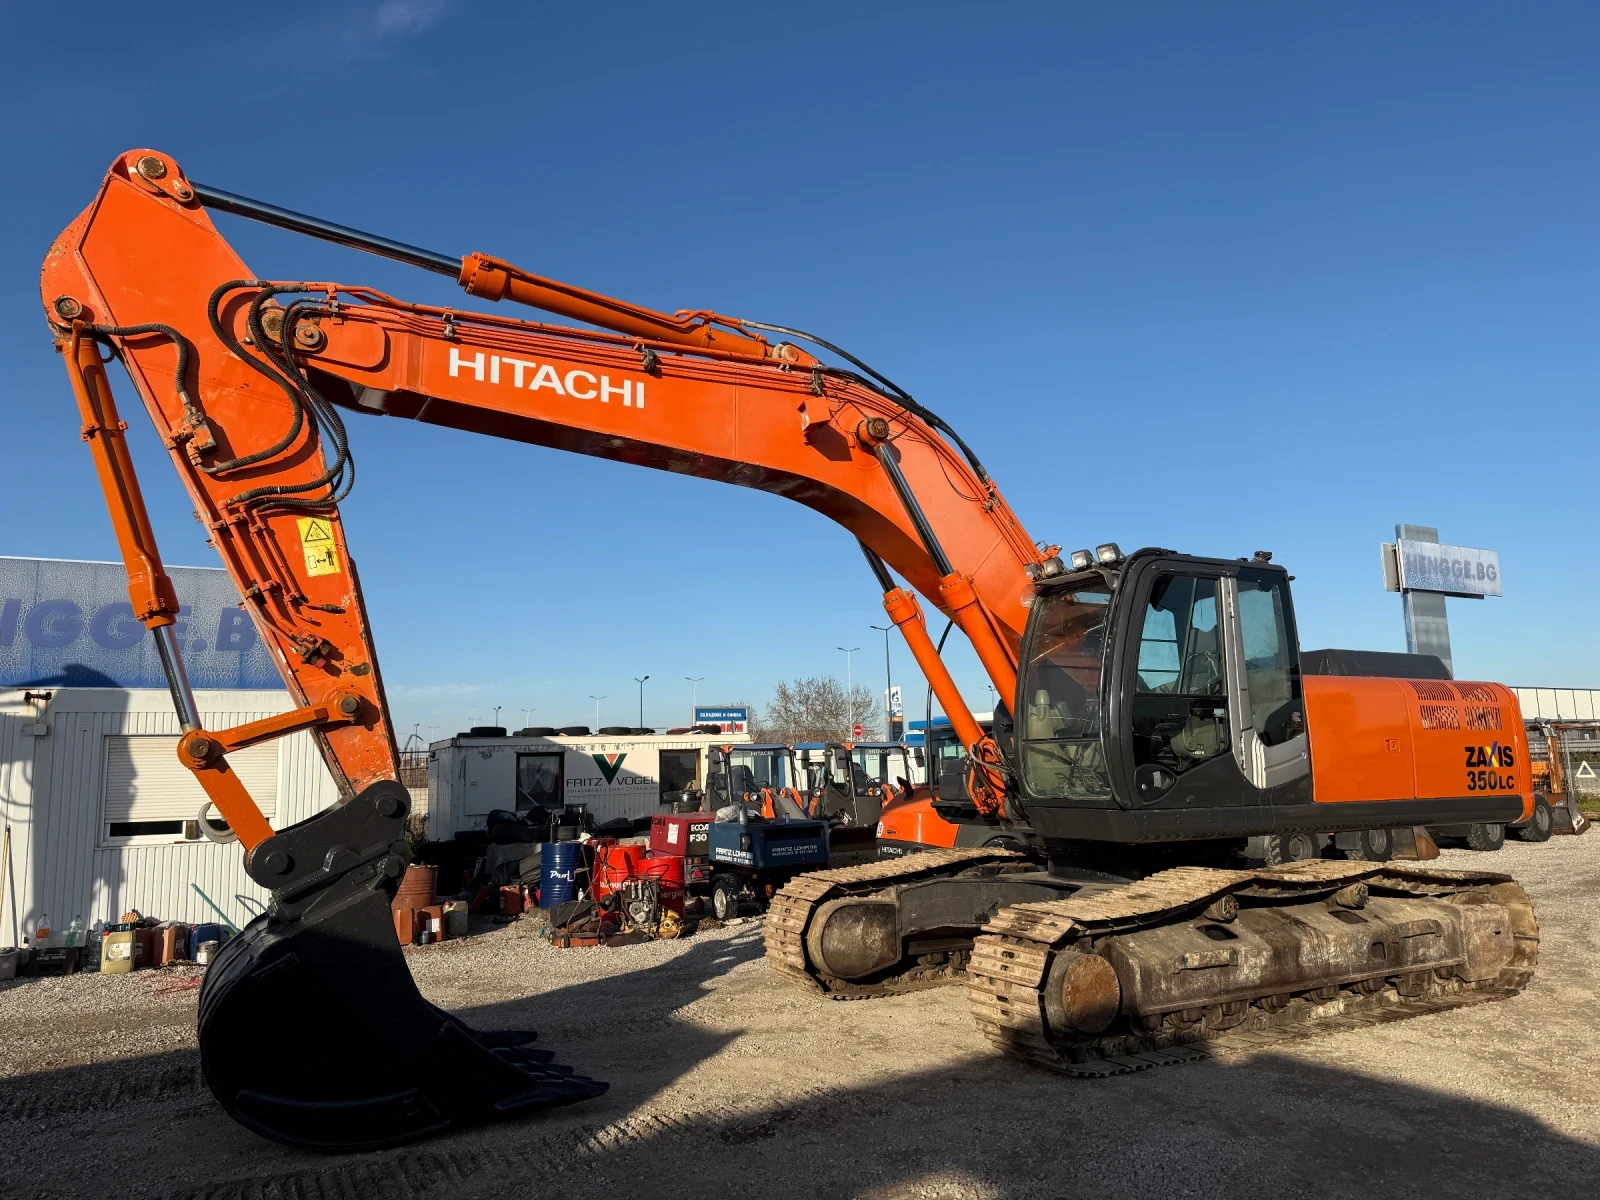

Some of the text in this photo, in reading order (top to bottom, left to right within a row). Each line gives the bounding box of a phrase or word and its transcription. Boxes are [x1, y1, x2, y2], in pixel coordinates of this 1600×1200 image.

[449, 347, 645, 409] HITACHI
[720, 723, 743, 732] НАМ
[1464, 741, 1514, 767] ZAXIS
[566, 775, 659, 788] FRITZ VOGEL
[689, 833, 708, 842] F30
[715, 847, 747, 858] FRANZ LOHR
[881, 846, 903, 855] HITACHI
